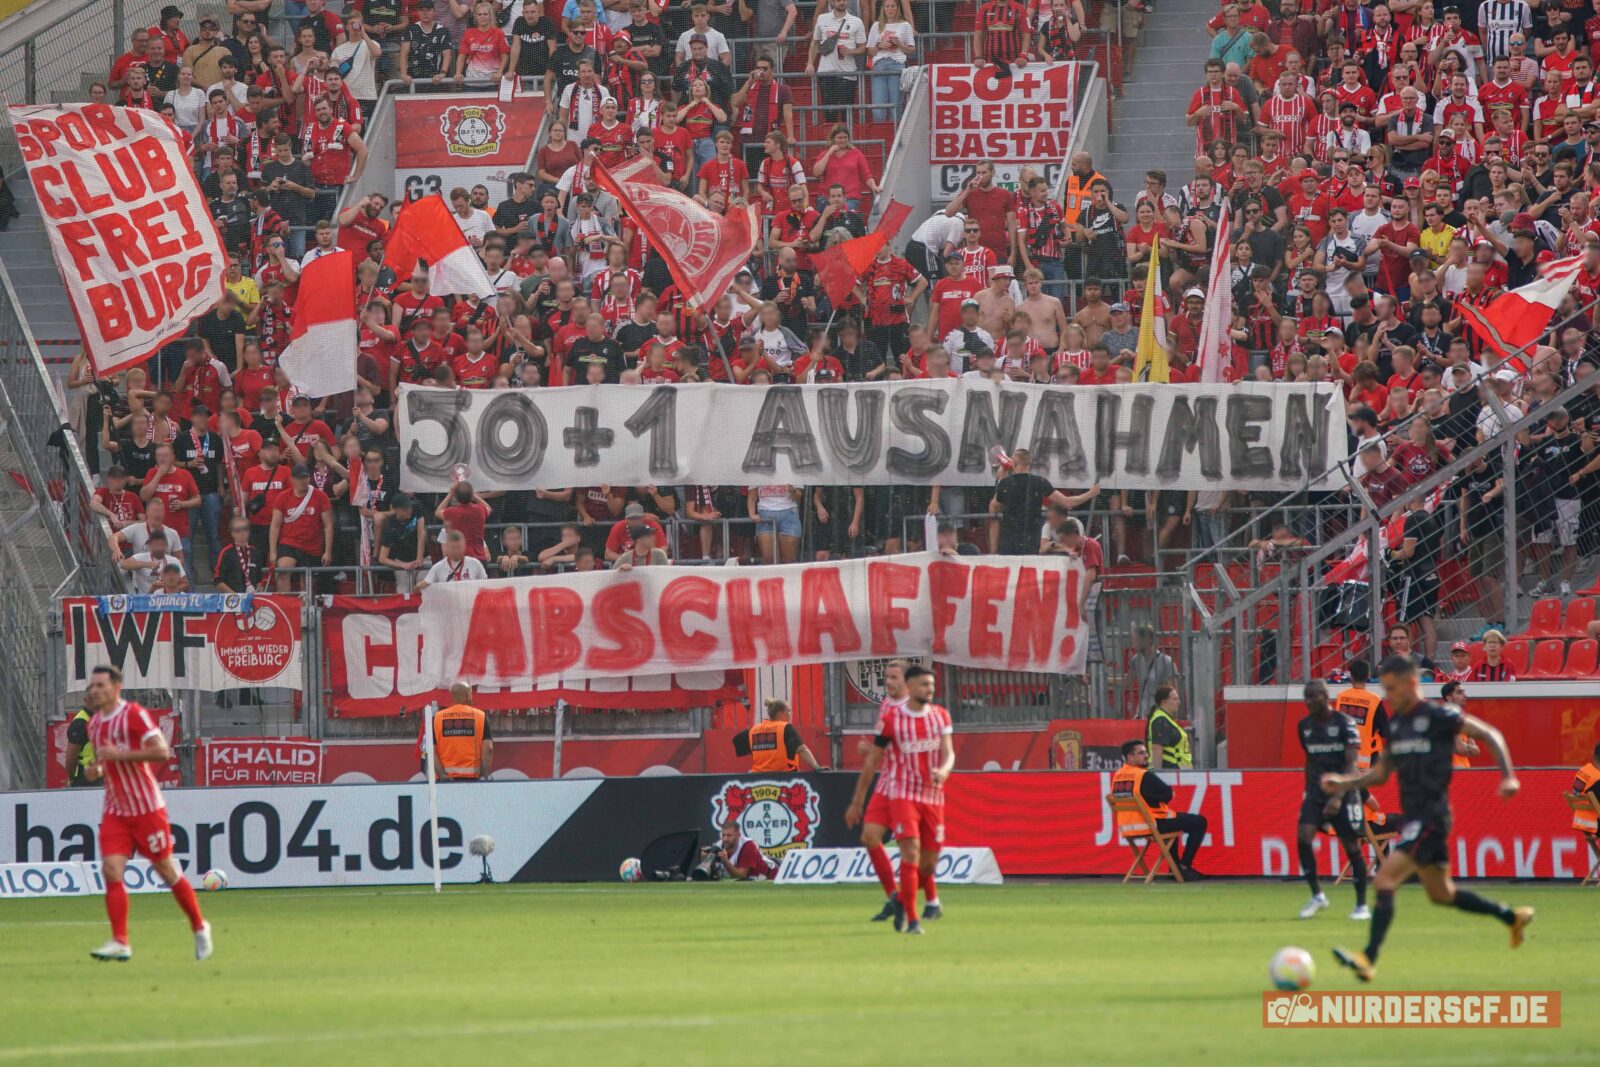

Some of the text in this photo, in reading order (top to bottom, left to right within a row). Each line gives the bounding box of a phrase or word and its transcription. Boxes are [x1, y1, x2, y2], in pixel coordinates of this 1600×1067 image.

[936, 64, 1070, 102] 50+1
[935, 103, 1072, 129] BLEIBT.
[935, 130, 1070, 157] BASTA!
[30, 135, 177, 220] CLUB
[56, 190, 204, 282] FREI
[86, 252, 213, 343] BURG
[404, 385, 1332, 483] 50+1 AUSNAHMEN
[459, 560, 1082, 678] ABSCHAFFEN!
[72, 606, 206, 681] IWF
[257, 643, 289, 654] WIEDER
[228, 652, 283, 668] FREIBURG
[211, 747, 316, 766] KHALID
[211, 766, 316, 783] FÜR IMMER
[754, 790, 778, 799] 1904
[747, 819, 788, 828] BAYER
[763, 803, 772, 845] BAYER
[1346, 803, 1363, 821] 19
[15, 795, 463, 876] baer04.de
[147, 830, 167, 853] 27
